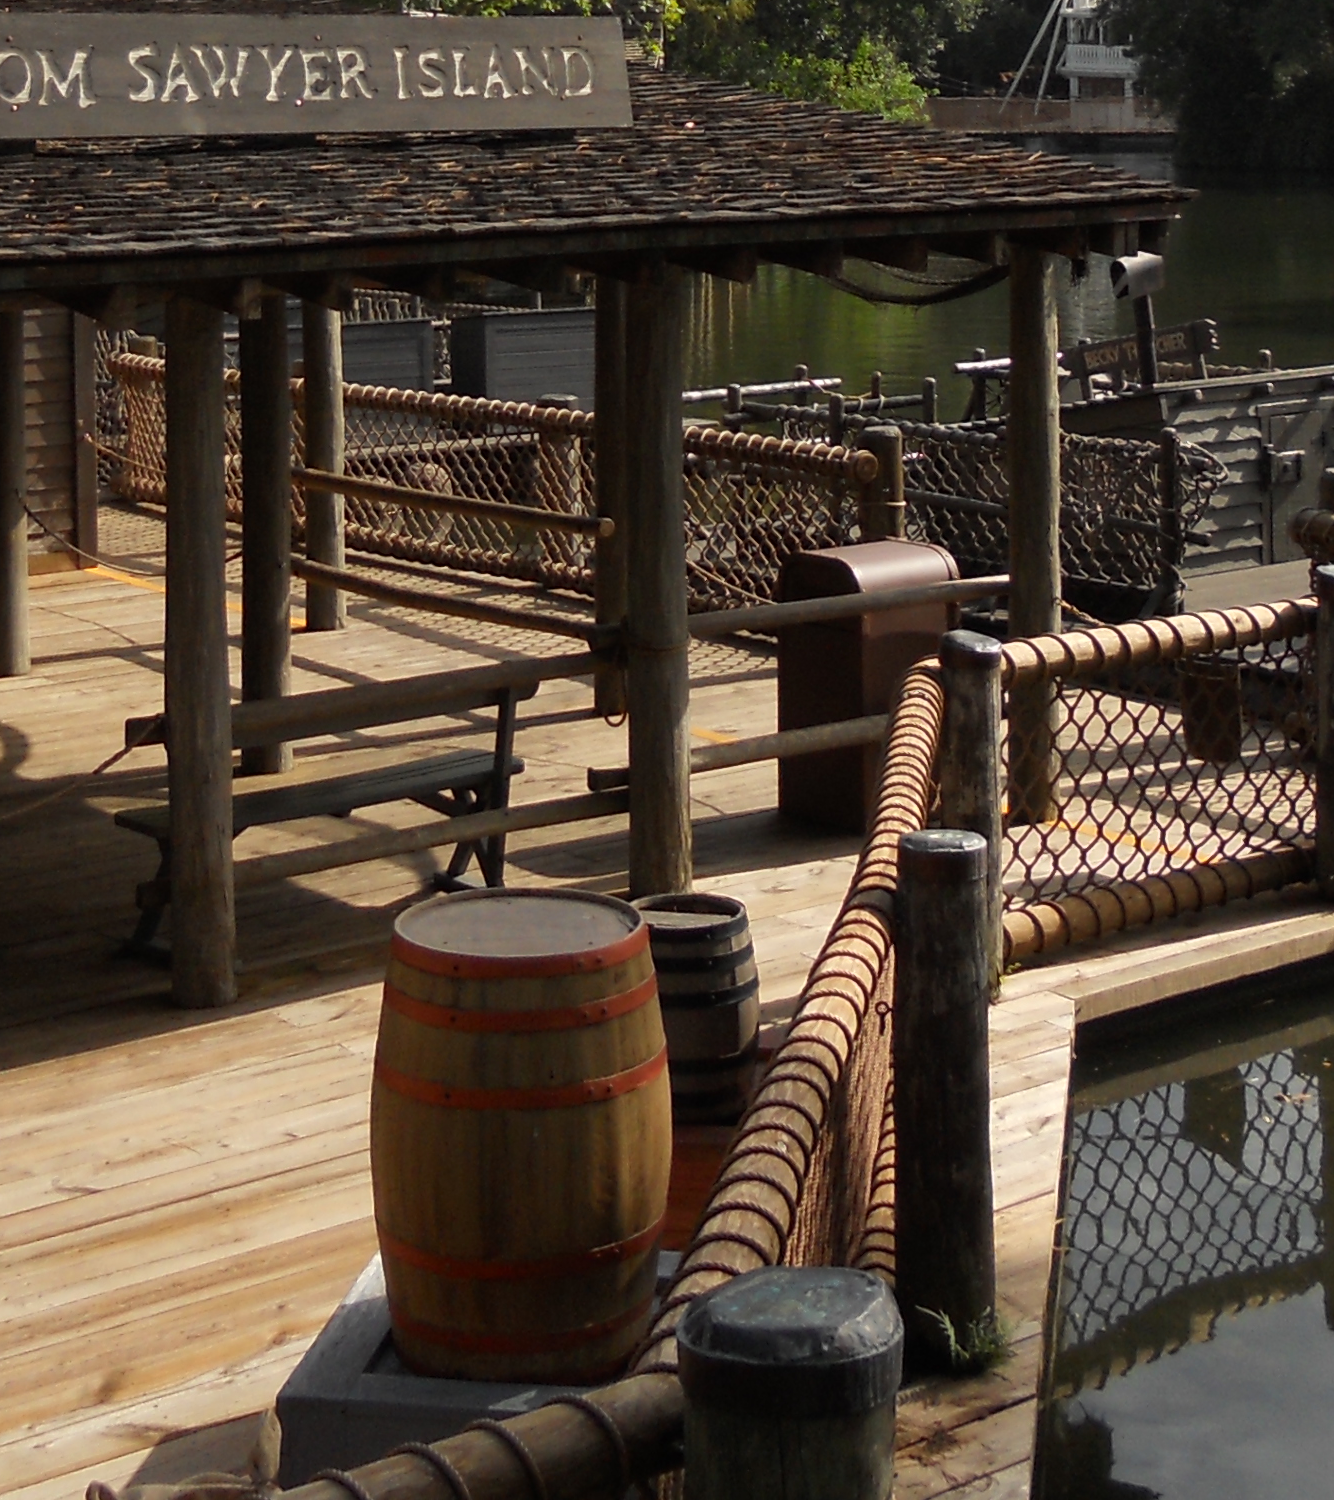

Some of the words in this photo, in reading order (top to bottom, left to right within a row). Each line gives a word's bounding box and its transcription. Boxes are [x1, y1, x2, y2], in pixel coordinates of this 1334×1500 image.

[128, 44, 373, 103] SAWYER
[392, 44, 593, 100] ISLAND
[1121, 332, 1187, 361] THCHER
